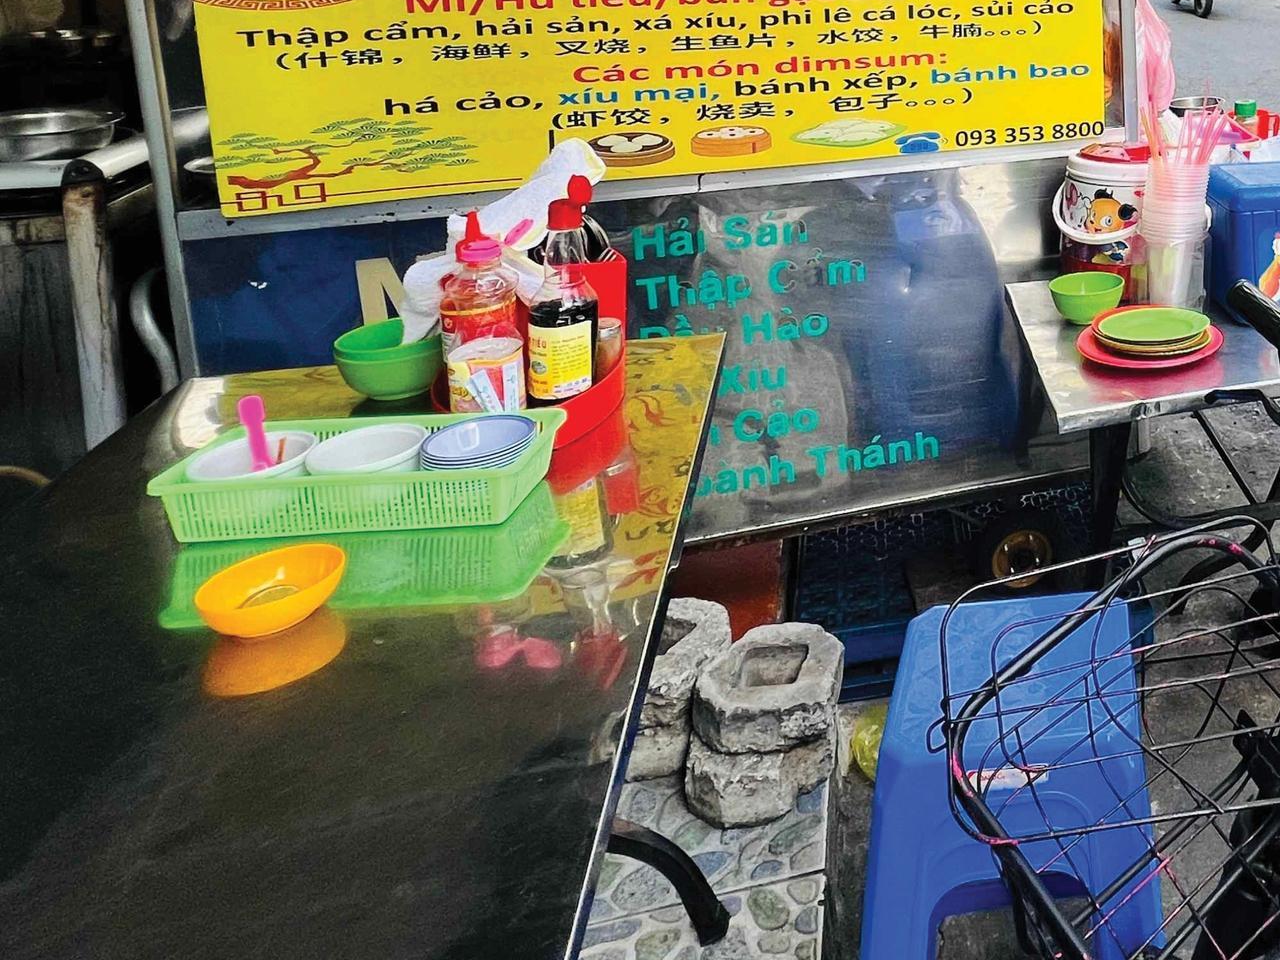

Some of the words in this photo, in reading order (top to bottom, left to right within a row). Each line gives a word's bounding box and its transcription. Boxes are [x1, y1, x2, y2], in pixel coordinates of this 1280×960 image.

[236, 27, 349, 48] Thập
[364, 21, 461, 41] cẩm,
[476, 18, 533, 37] hải
[547, 16, 621, 35] sản,
[633, 14, 672, 31] xá
[684, 12, 747, 30] xíu,
[760, 9, 811, 29] phi
[824, 7, 852, 24] lê
[863, 6, 896, 22] cá
[907, 4, 961, 21] lóc,
[971, 1, 1013, 17] sủi
[384, 96, 440, 116] há
[455, 91, 544, 111] cảo,
[559, 87, 617, 105] xíu
[634, 82, 720, 103] mại,
[734, 77, 830, 97] bánh
[843, 70, 918, 90] xếp,
[930, 65, 1017, 84] bánh
[1029, 63, 1090, 78] bao
[573, 64, 650, 84] Các
[665, 60, 760, 80] món
[775, 51, 948, 73] dimsum:
[955, 130, 997, 148] 093
[1003, 126, 1044, 143] 353
[1051, 121, 1105, 140] 8800
[807, 431, 941, 478] Thánh
